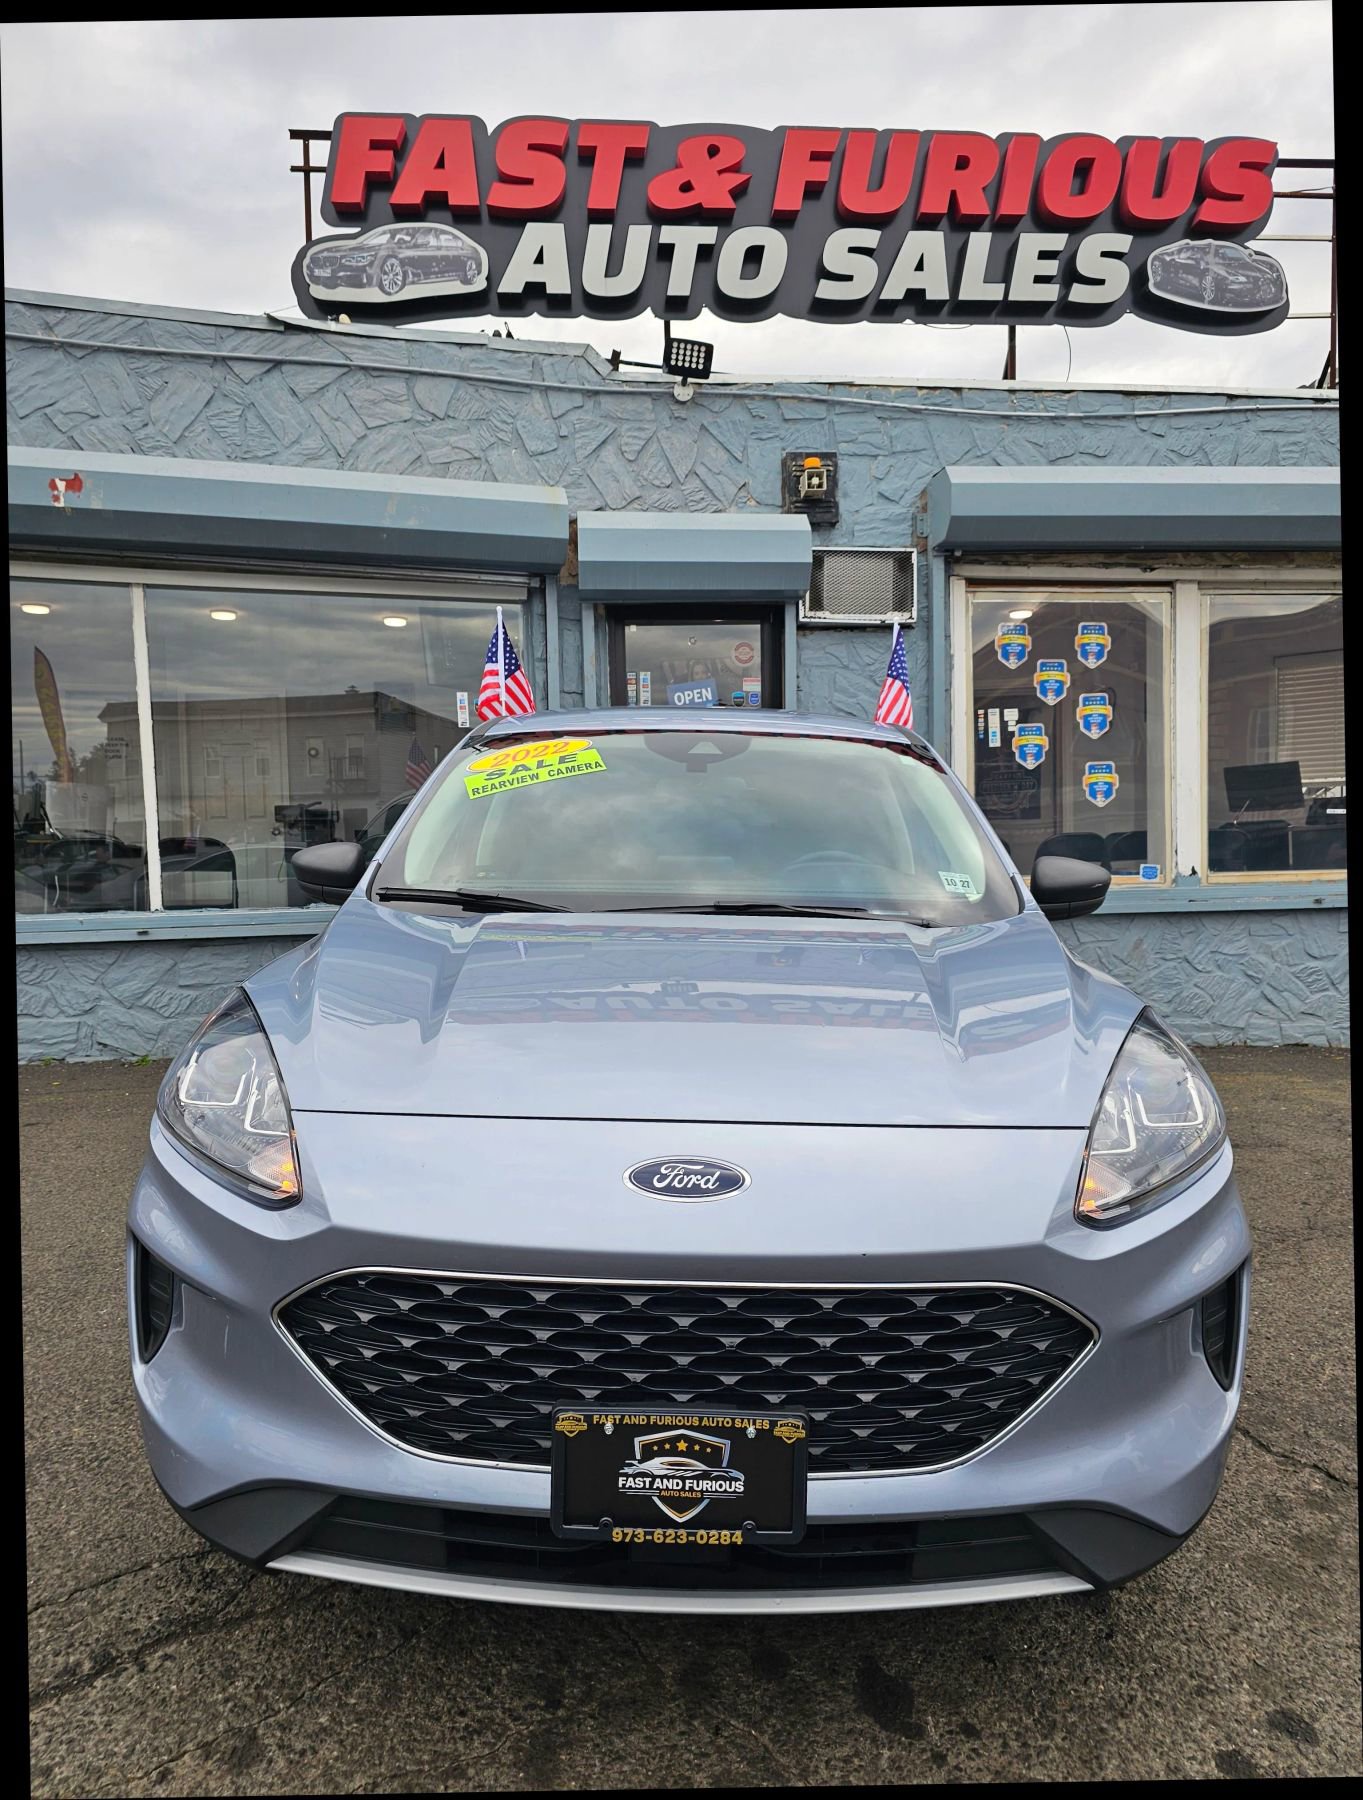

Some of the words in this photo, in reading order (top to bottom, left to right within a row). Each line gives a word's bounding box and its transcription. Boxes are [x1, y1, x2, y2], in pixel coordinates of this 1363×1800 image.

[331, 116, 651, 218] FAST
[647, 134, 753, 218] &
[770, 128, 1278, 233] FURIOUS
[496, 222, 789, 300] AUTO
[814, 227, 1134, 304] SALES
[674, 687, 713, 706] OPEN
[489, 741, 570, 768] 2022
[484, 753, 578, 781] SALE
[471, 773, 540, 796] REARVIEW
[547, 761, 603, 778] CAMERA
[944, 877, 957, 887] 10
[960, 879, 970, 889] 27
[653, 1163, 721, 1189] Ford
[593, 1414, 621, 1425] FAST
[623, 1415, 647, 1425] AND
[650, 1415, 699, 1426] FURIOUS
[701, 1417, 732, 1427] AUTO
[734, 1418, 770, 1430] SALES
[618, 1477, 653, 1489] FAST
[653, 1478, 683, 1490] AND
[685, 1480, 745, 1492] FURIOUS
[680, 1490, 701, 1498] SALES
[612, 1527, 744, 1545] 973-623-0284
